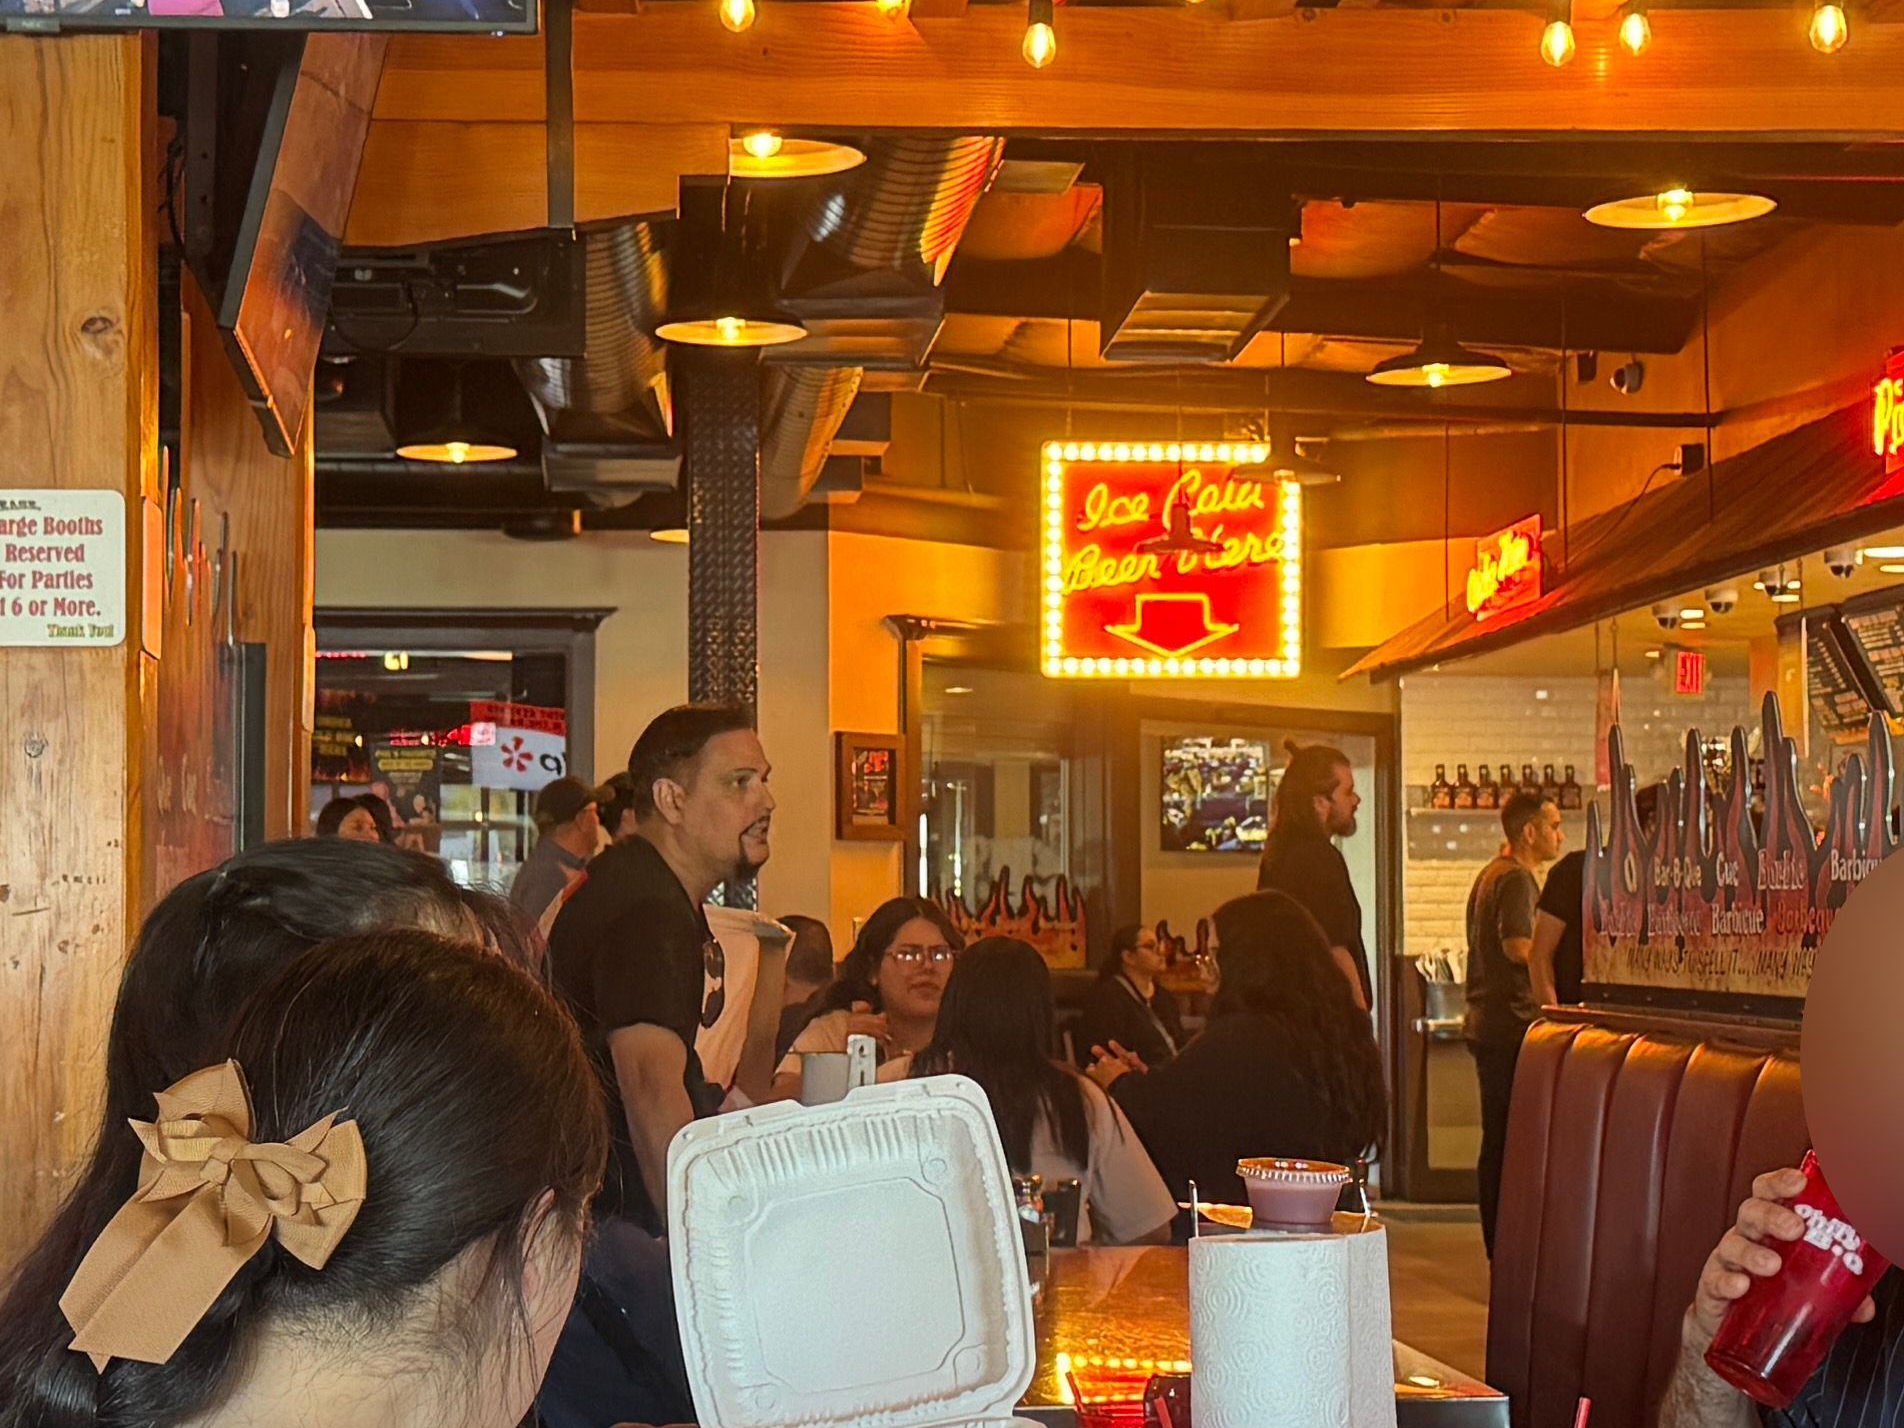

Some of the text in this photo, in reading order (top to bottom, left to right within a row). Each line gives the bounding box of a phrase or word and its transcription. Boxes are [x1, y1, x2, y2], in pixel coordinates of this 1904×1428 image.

[1076, 483, 1149, 530] Ice
[43, 516, 104, 536] Booths
[5, 543, 85, 563] Reserved
[1062, 543, 1161, 595] Beer
[31, 570, 93, 590] Parties
[11, 597, 23, 616] 6
[28, 600, 48, 616] or
[53, 598, 101, 616] More.
[1716, 851, 1739, 887] Cue
